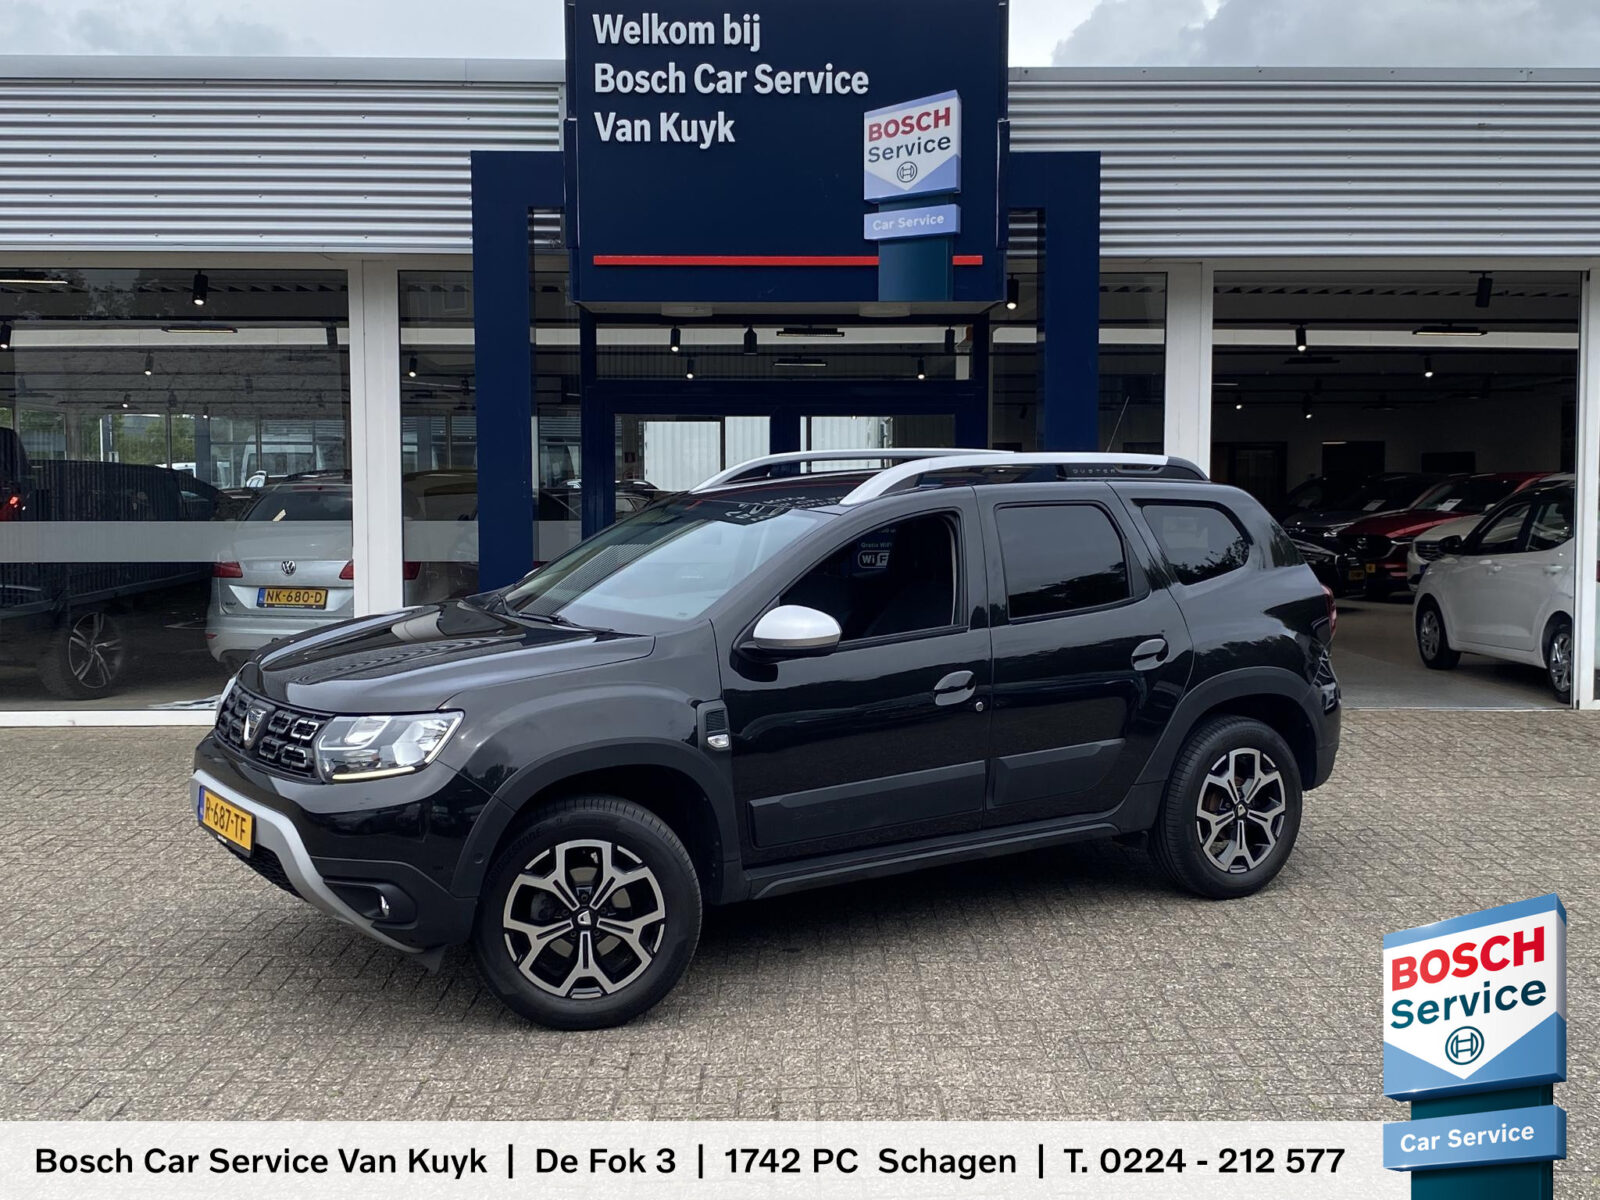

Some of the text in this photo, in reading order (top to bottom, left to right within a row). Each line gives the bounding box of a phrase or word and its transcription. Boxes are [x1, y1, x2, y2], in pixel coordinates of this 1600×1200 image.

[593, 13, 761, 51] Welkom bij
[594, 62, 869, 94] Bosch Car Service
[594, 111, 736, 149] Van Kuyk
[868, 107, 951, 142] BOSCH
[868, 136, 951, 163] Service
[873, 214, 944, 231] Car Service
[266, 590, 323, 603] NK-680-D
[205, 796, 247, 841] R-687-TF
